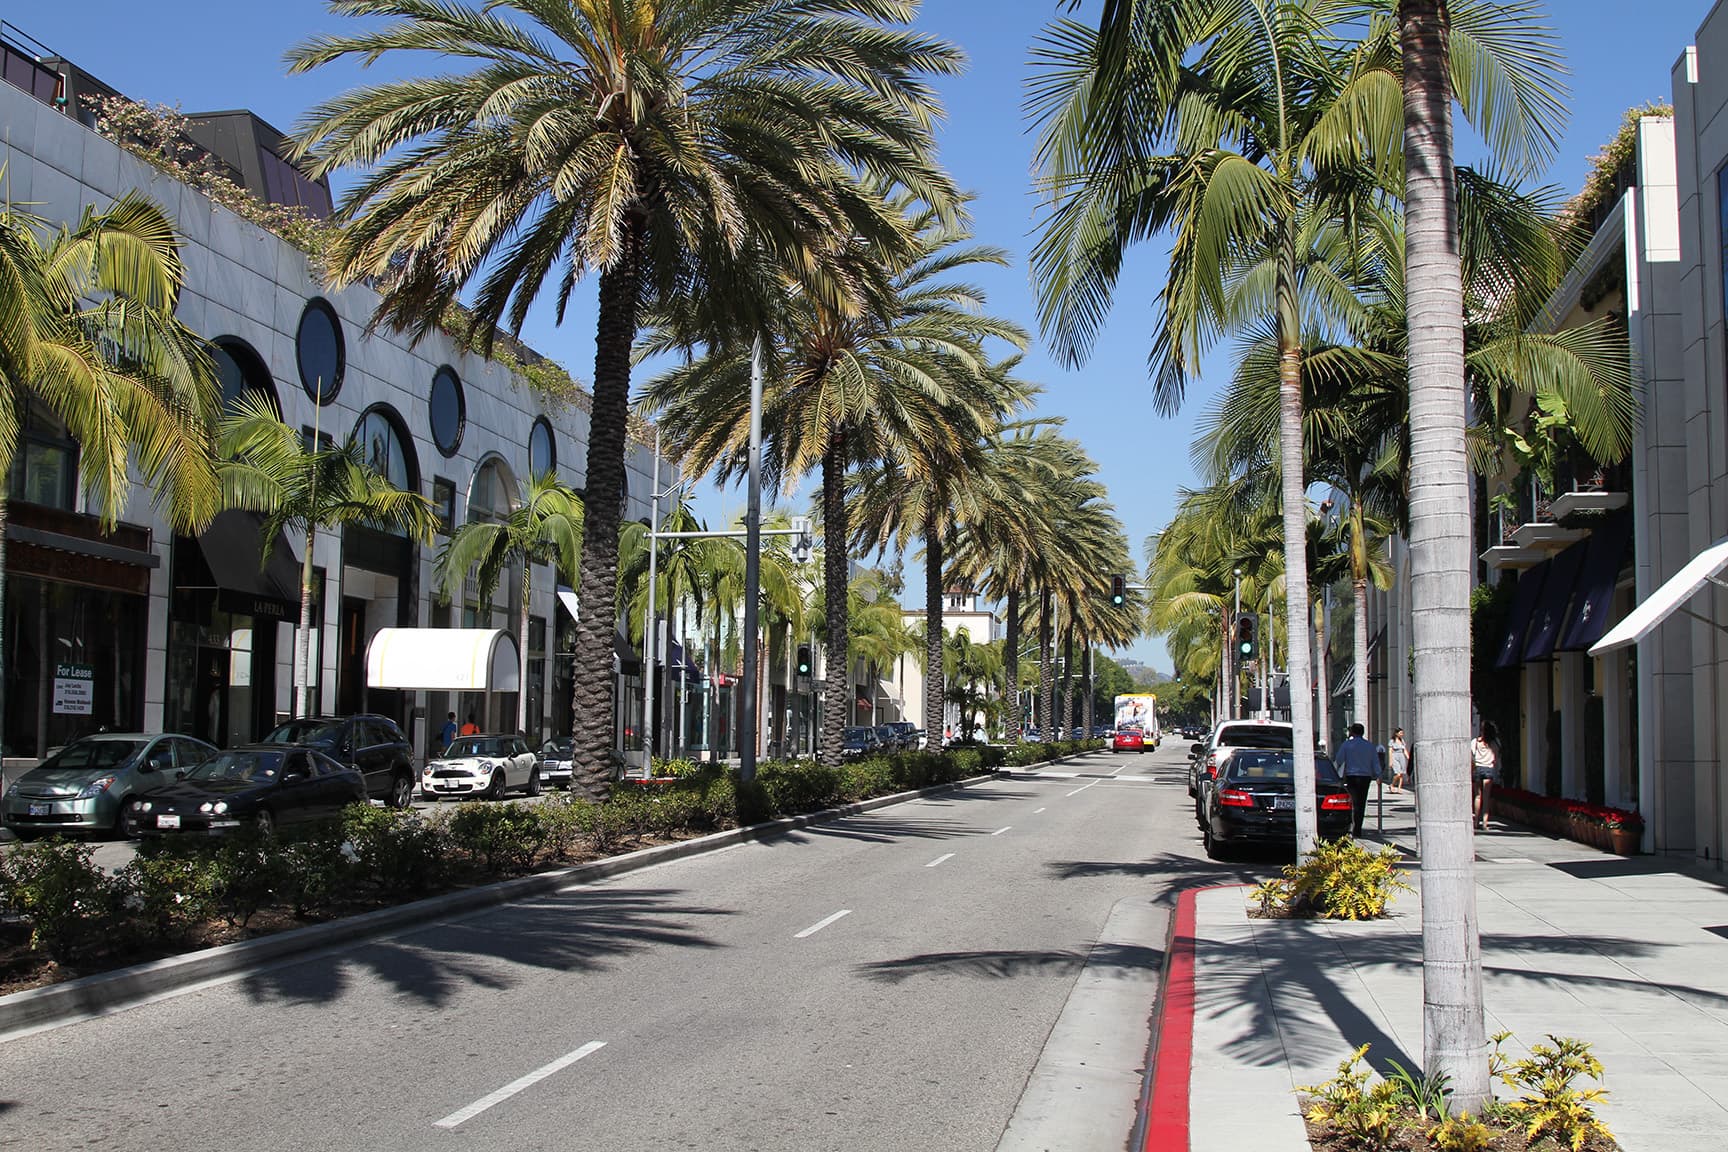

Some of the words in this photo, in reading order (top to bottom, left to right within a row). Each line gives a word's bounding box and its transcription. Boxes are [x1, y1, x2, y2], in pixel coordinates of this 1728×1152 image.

[254, 599, 263, 614] LA
[264, 601, 285, 616] PERLA
[57, 664, 70, 676] For
[71, 665, 92, 678] Lease
